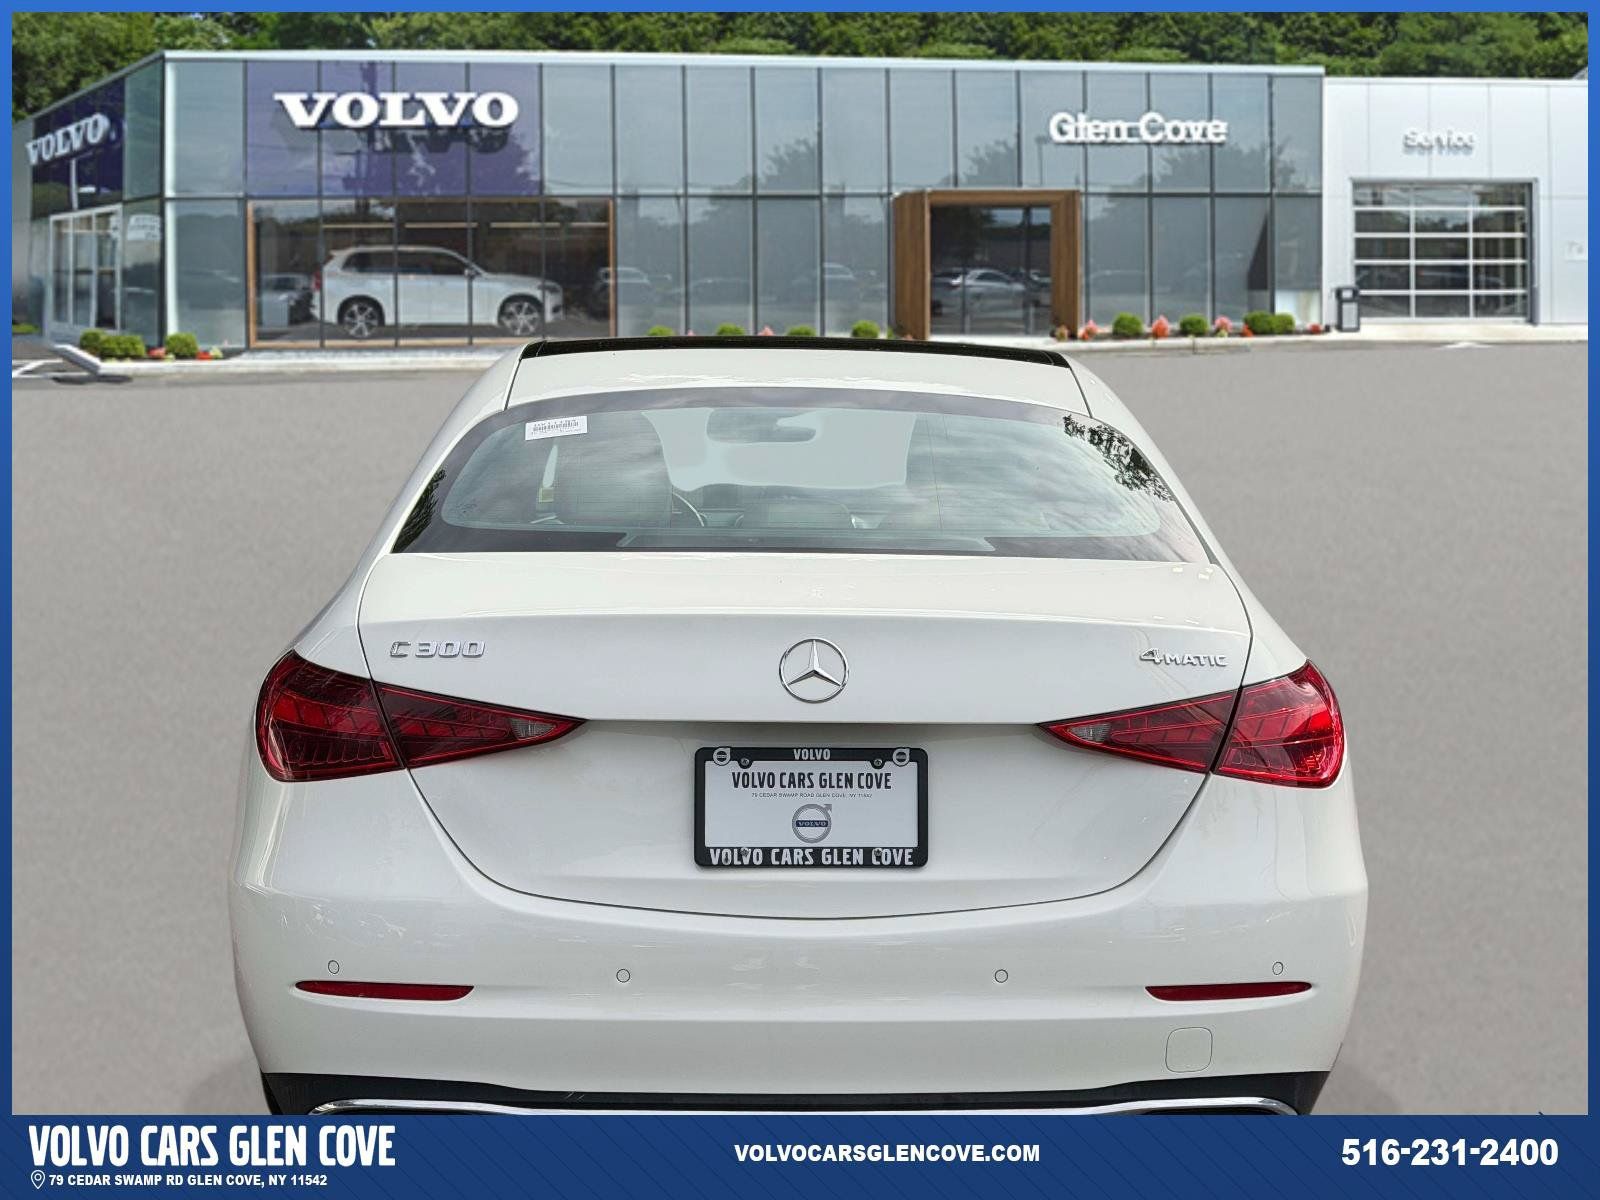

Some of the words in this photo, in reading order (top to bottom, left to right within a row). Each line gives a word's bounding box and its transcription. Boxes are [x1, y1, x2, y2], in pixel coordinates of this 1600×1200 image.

[273, 92, 519, 128] VOLVO
[1049, 112, 1131, 144] Glen
[1138, 112, 1228, 144] Cove
[25, 113, 111, 166] VOLVO
[1402, 129, 1476, 154] Service
[390, 641, 411, 658] C
[414, 640, 485, 658] 300
[1139, 647, 1228, 667] 4MATIC
[793, 748, 831, 761] VOLVO
[731, 771, 776, 789] VOLVO
[779, 771, 815, 789] CARS
[818, 772, 854, 789] GLEN
[857, 772, 892, 790] COVE
[710, 848, 763, 866] VOLVO
[771, 848, 814, 866] CARS
[821, 848, 864, 866] GLEN
[872, 848, 914, 866] COVE
